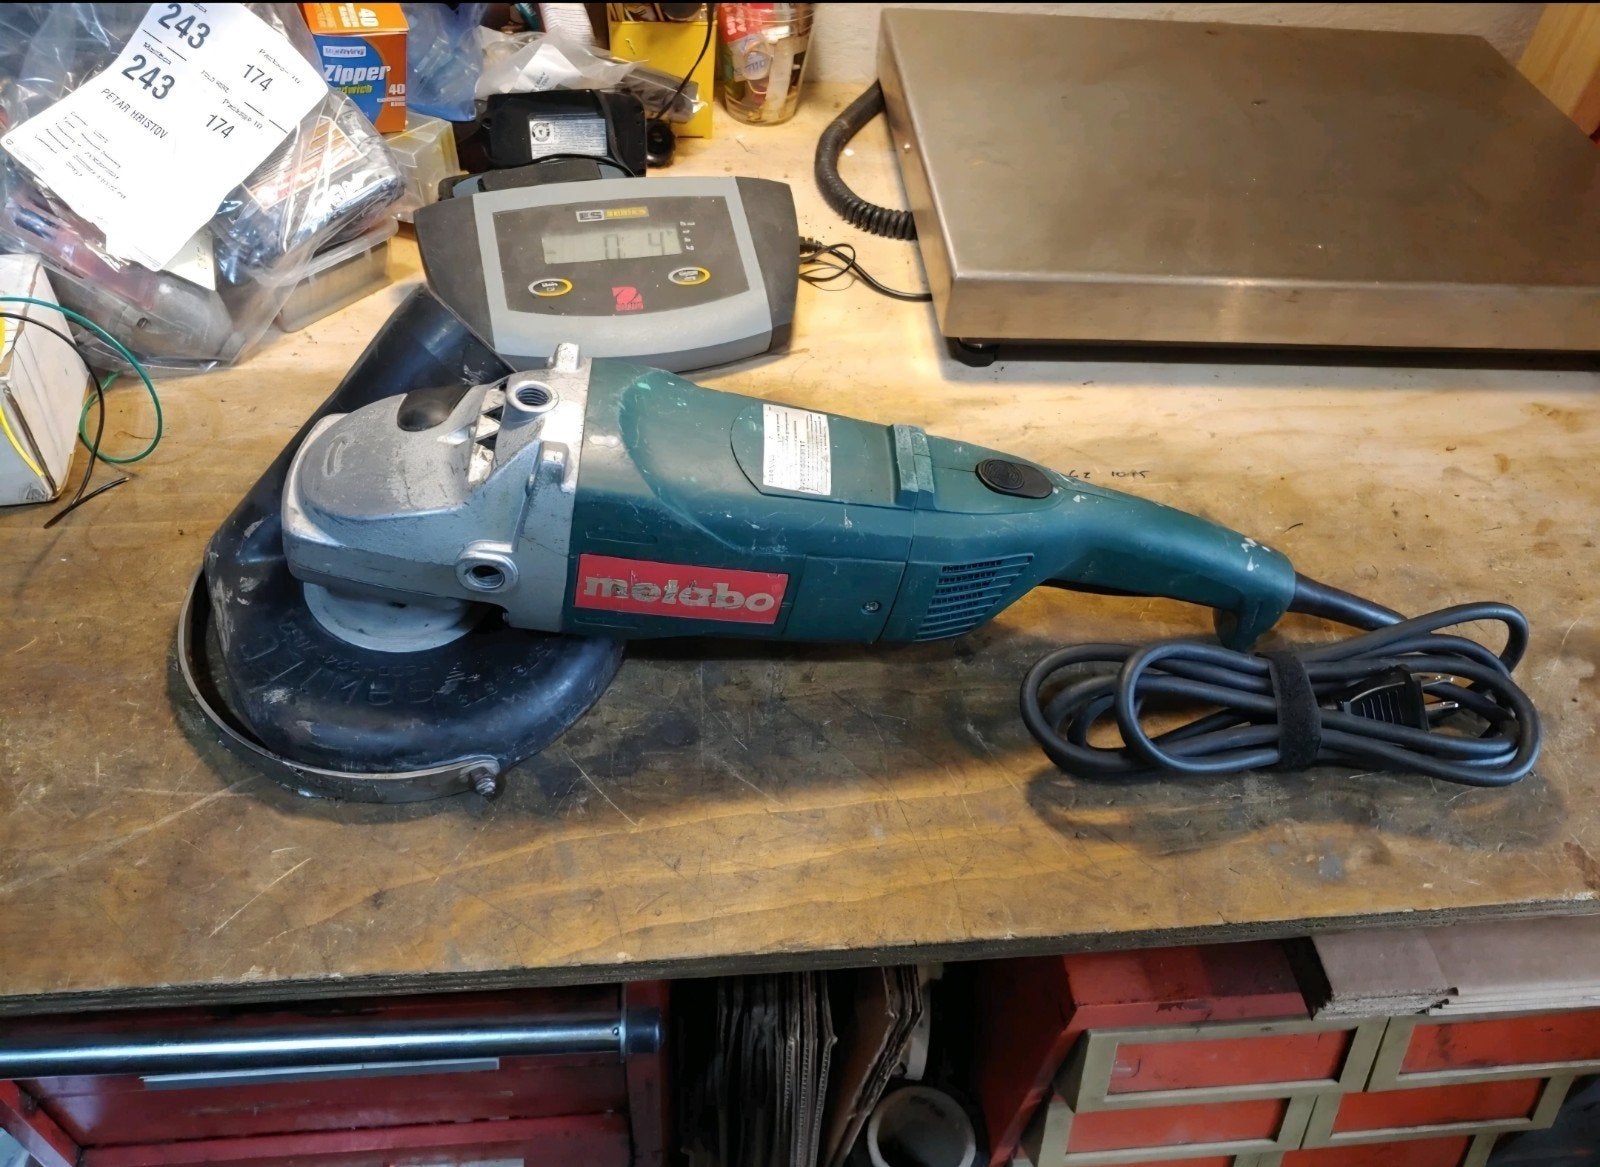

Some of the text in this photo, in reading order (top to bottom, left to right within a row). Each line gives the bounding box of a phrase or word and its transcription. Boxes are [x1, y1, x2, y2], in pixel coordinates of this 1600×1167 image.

[157, 3, 211, 49] 243
[121, 54, 175, 100] 243
[243, 64, 273, 91] 174
[323, 64, 391, 85] Zipper
[388, 83, 406, 95] 40
[100, 88, 131, 113] PETAR
[130, 109, 169, 139] HRISTOV
[206, 114, 235, 138] 174
[583, 576, 775, 612] metabo
